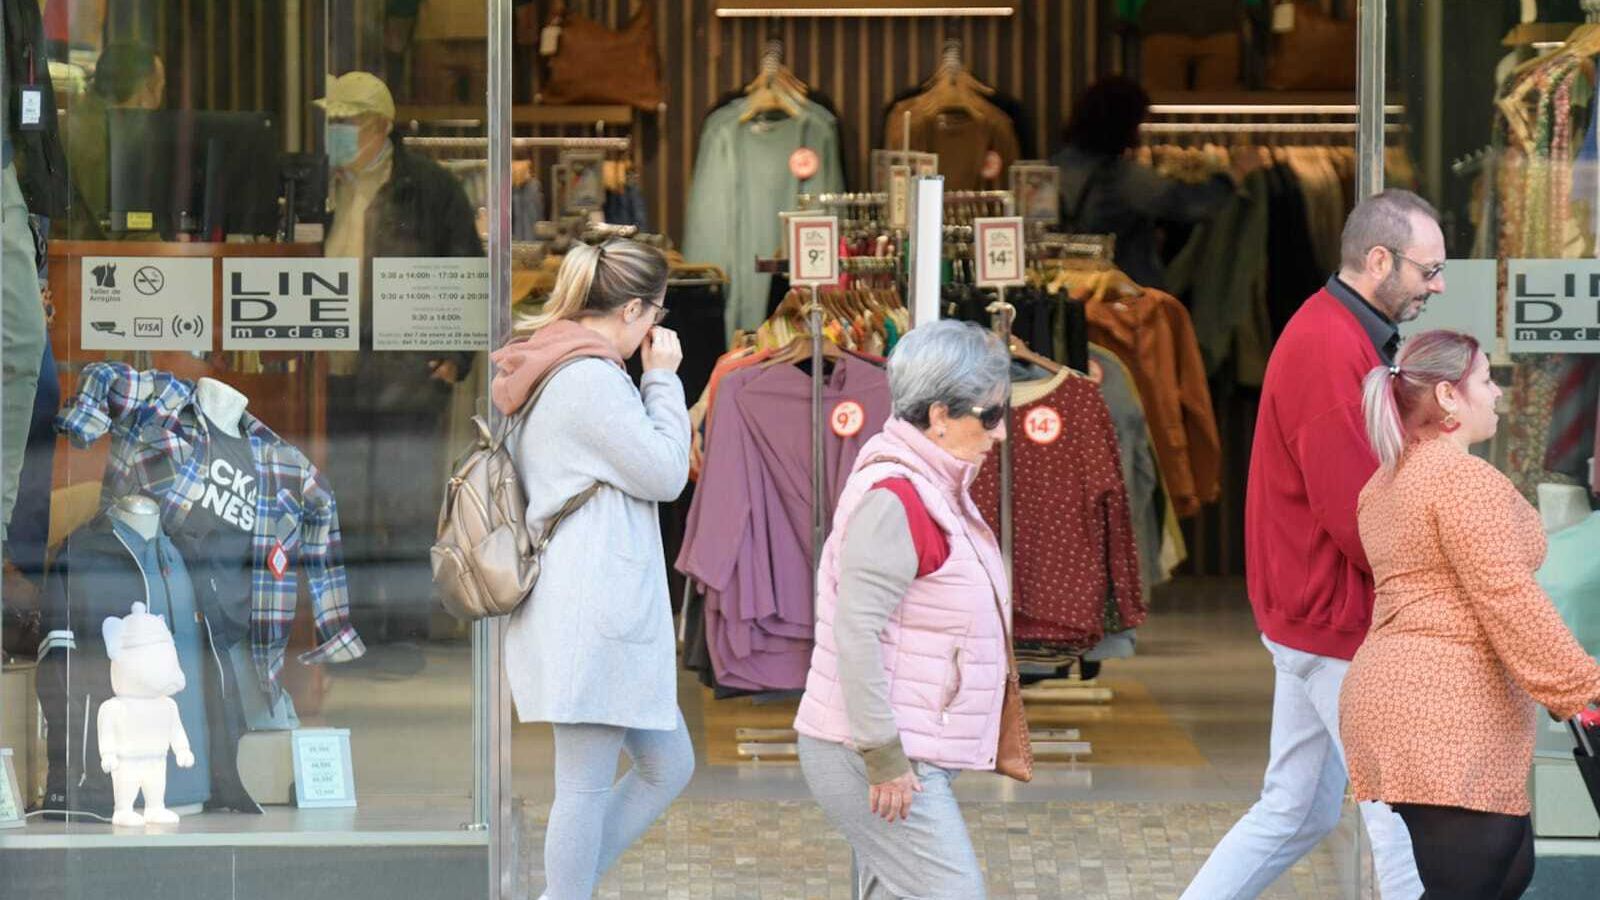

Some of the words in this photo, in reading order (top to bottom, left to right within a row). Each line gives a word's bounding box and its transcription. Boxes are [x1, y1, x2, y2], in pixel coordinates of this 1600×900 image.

[232, 272, 348, 295] LIN
[1516, 300, 1600, 324] D
[138, 323, 160, 332] VISA
[235, 326, 345, 338] modas
[1519, 328, 1600, 340] mod
[1029, 416, 1048, 434] 14
